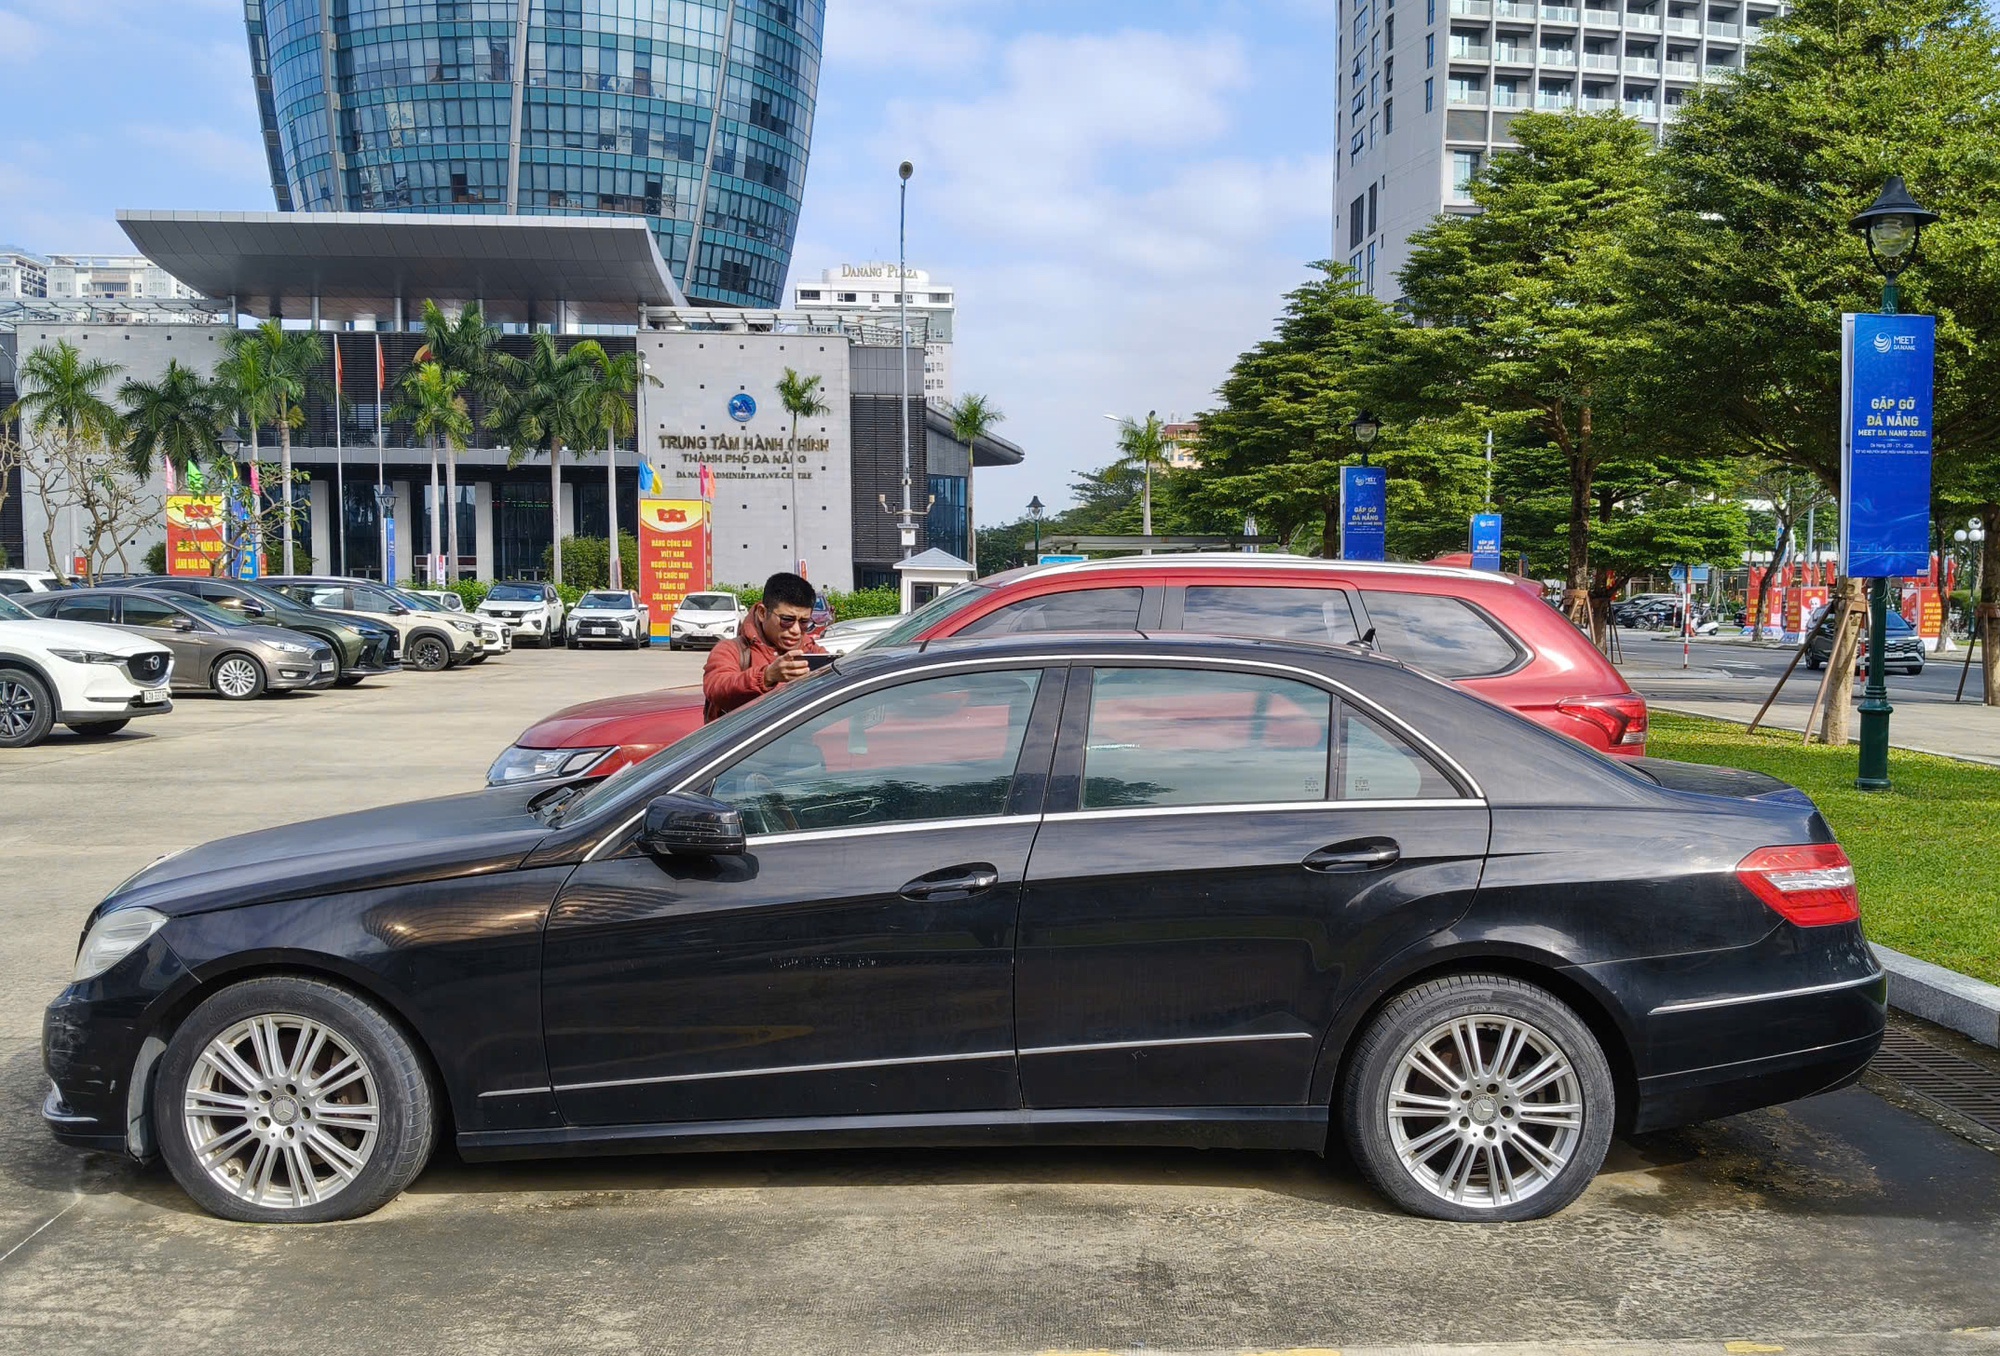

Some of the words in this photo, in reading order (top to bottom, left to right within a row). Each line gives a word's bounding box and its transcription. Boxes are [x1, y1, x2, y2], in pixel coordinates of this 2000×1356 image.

[841, 263, 882, 278] DANANG
[1893, 335, 1916, 344] MEET
[1871, 395, 1896, 412] GẶP
[1898, 396, 1916, 410] GỠ
[1866, 412, 1883, 427] ĐÀ
[1886, 410, 1919, 427] NẴNG
[1858, 429, 1876, 437] MEET
[1878, 429, 1887, 437] DA
[659, 435, 707, 450] TRUNG
[711, 433, 740, 451] TÂM
[743, 433, 784, 452] HÀNH
[682, 451, 722, 463] THÀNH
[725, 451, 750, 464] PHỐ
[752, 452, 770, 464] ĐÀ
[772, 451, 807, 465] NẴG
[676, 471, 686, 479] DA
[687, 471, 705, 479] NA
[781, 472, 813, 480] CETRE
